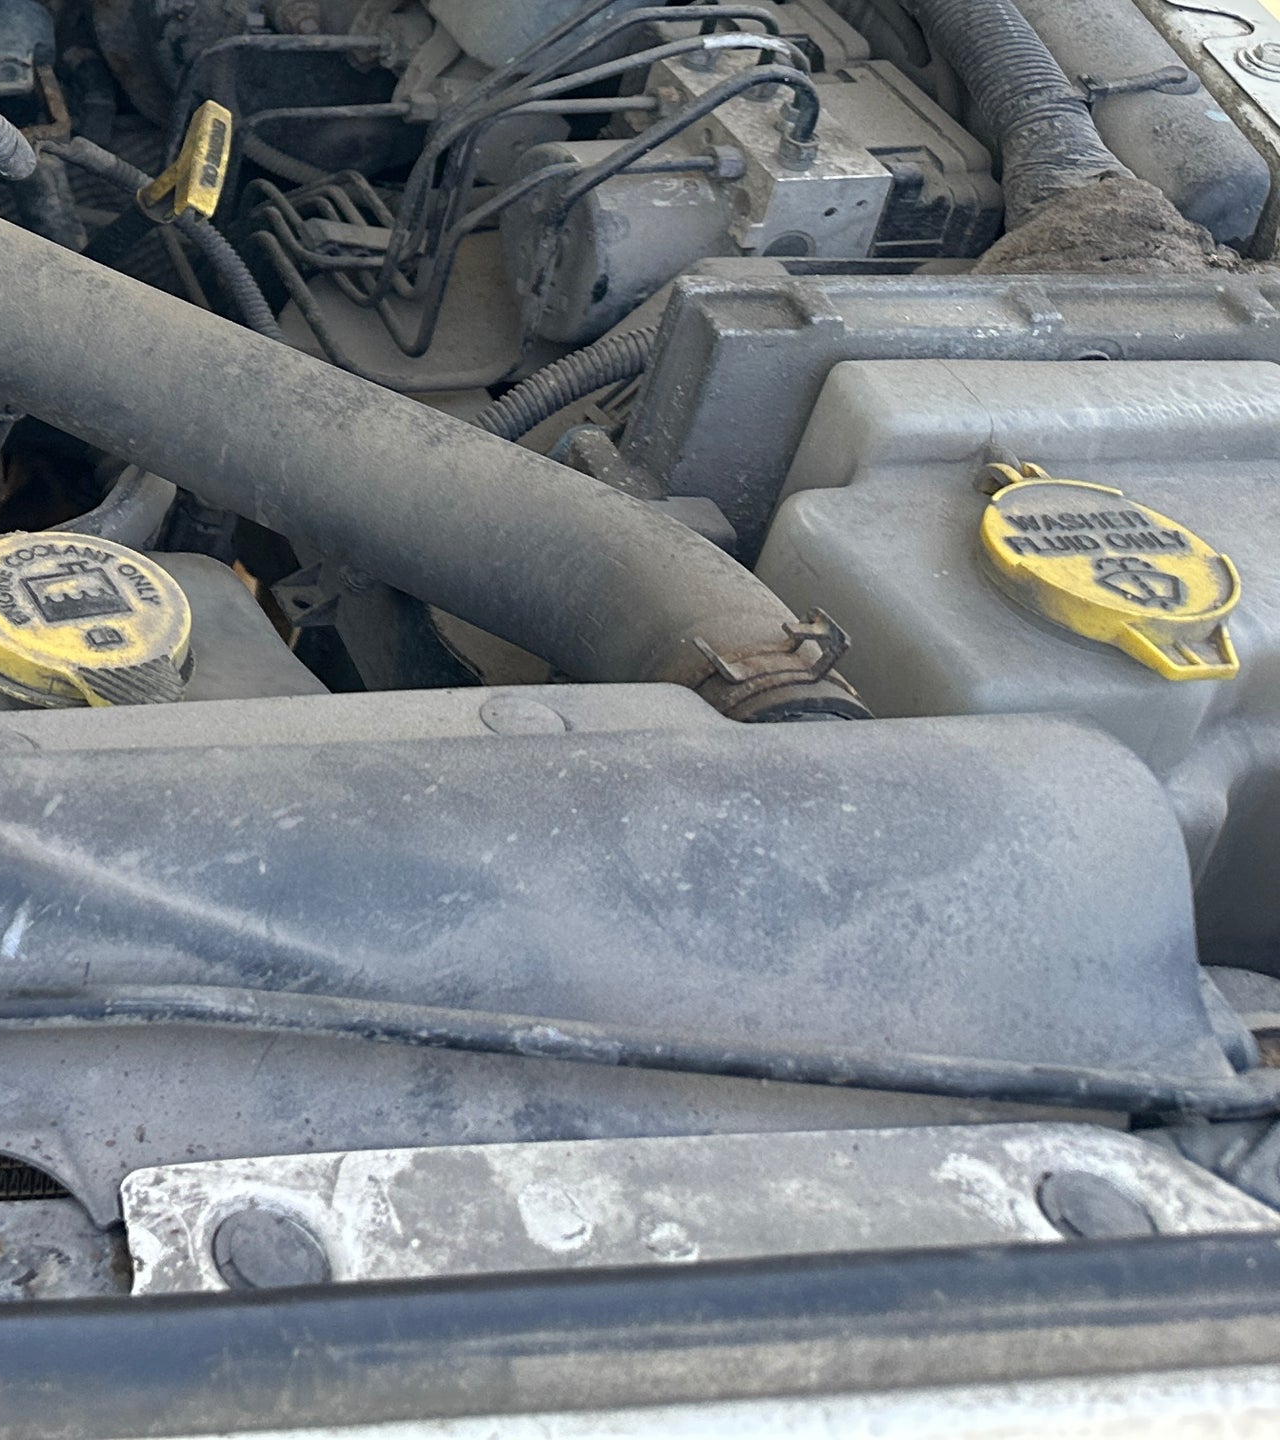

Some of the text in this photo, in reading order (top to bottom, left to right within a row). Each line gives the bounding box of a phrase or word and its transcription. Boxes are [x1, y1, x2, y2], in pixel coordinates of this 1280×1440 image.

[1004, 509, 1150, 532] WASHER
[1004, 530, 1188, 556] FLUID ONLY
[4, 544, 115, 567] COOLANT
[119, 564, 161, 606] ONLY
